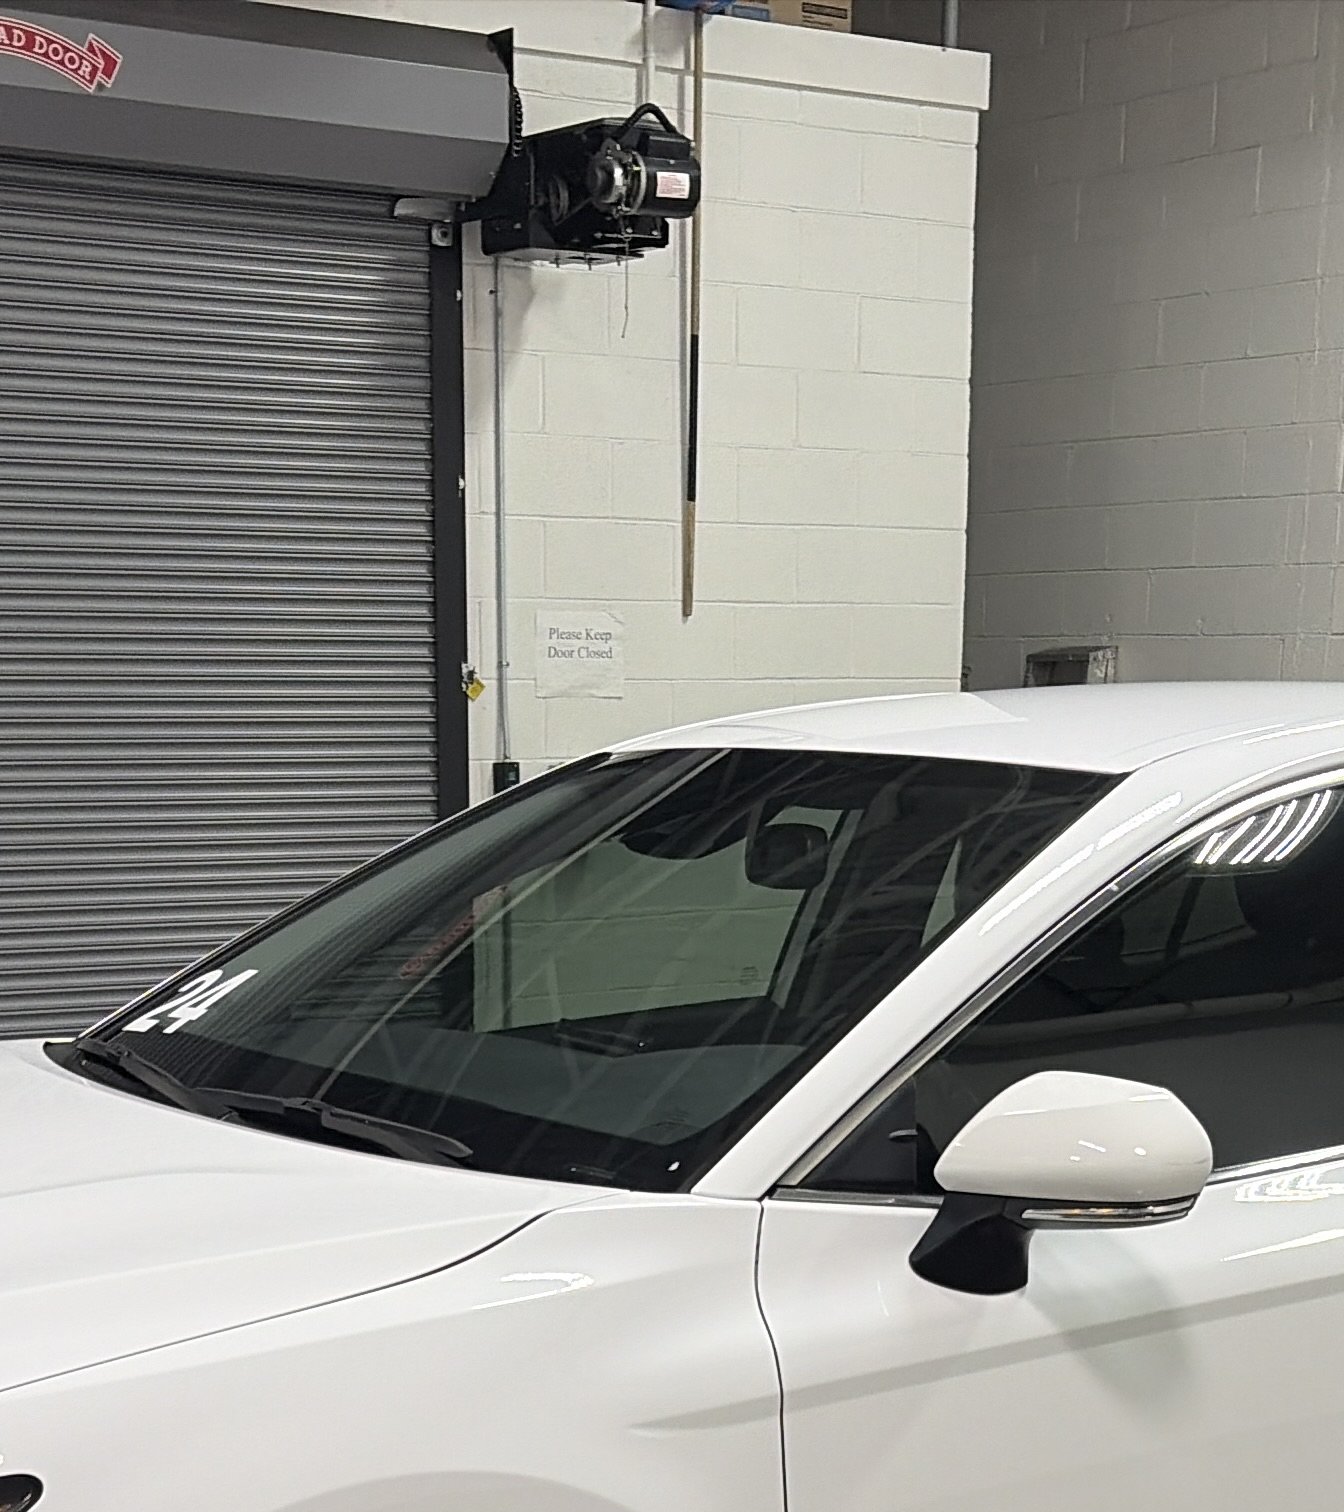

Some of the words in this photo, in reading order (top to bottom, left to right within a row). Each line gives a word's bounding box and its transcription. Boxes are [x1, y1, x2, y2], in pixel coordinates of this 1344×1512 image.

[33, 37, 94, 81] DOOR
[548, 627, 583, 640] Please
[585, 628, 612, 643] Keep
[547, 646, 575, 659] Door
[577, 646, 613, 659] Closed
[121, 968, 260, 1035] 24
